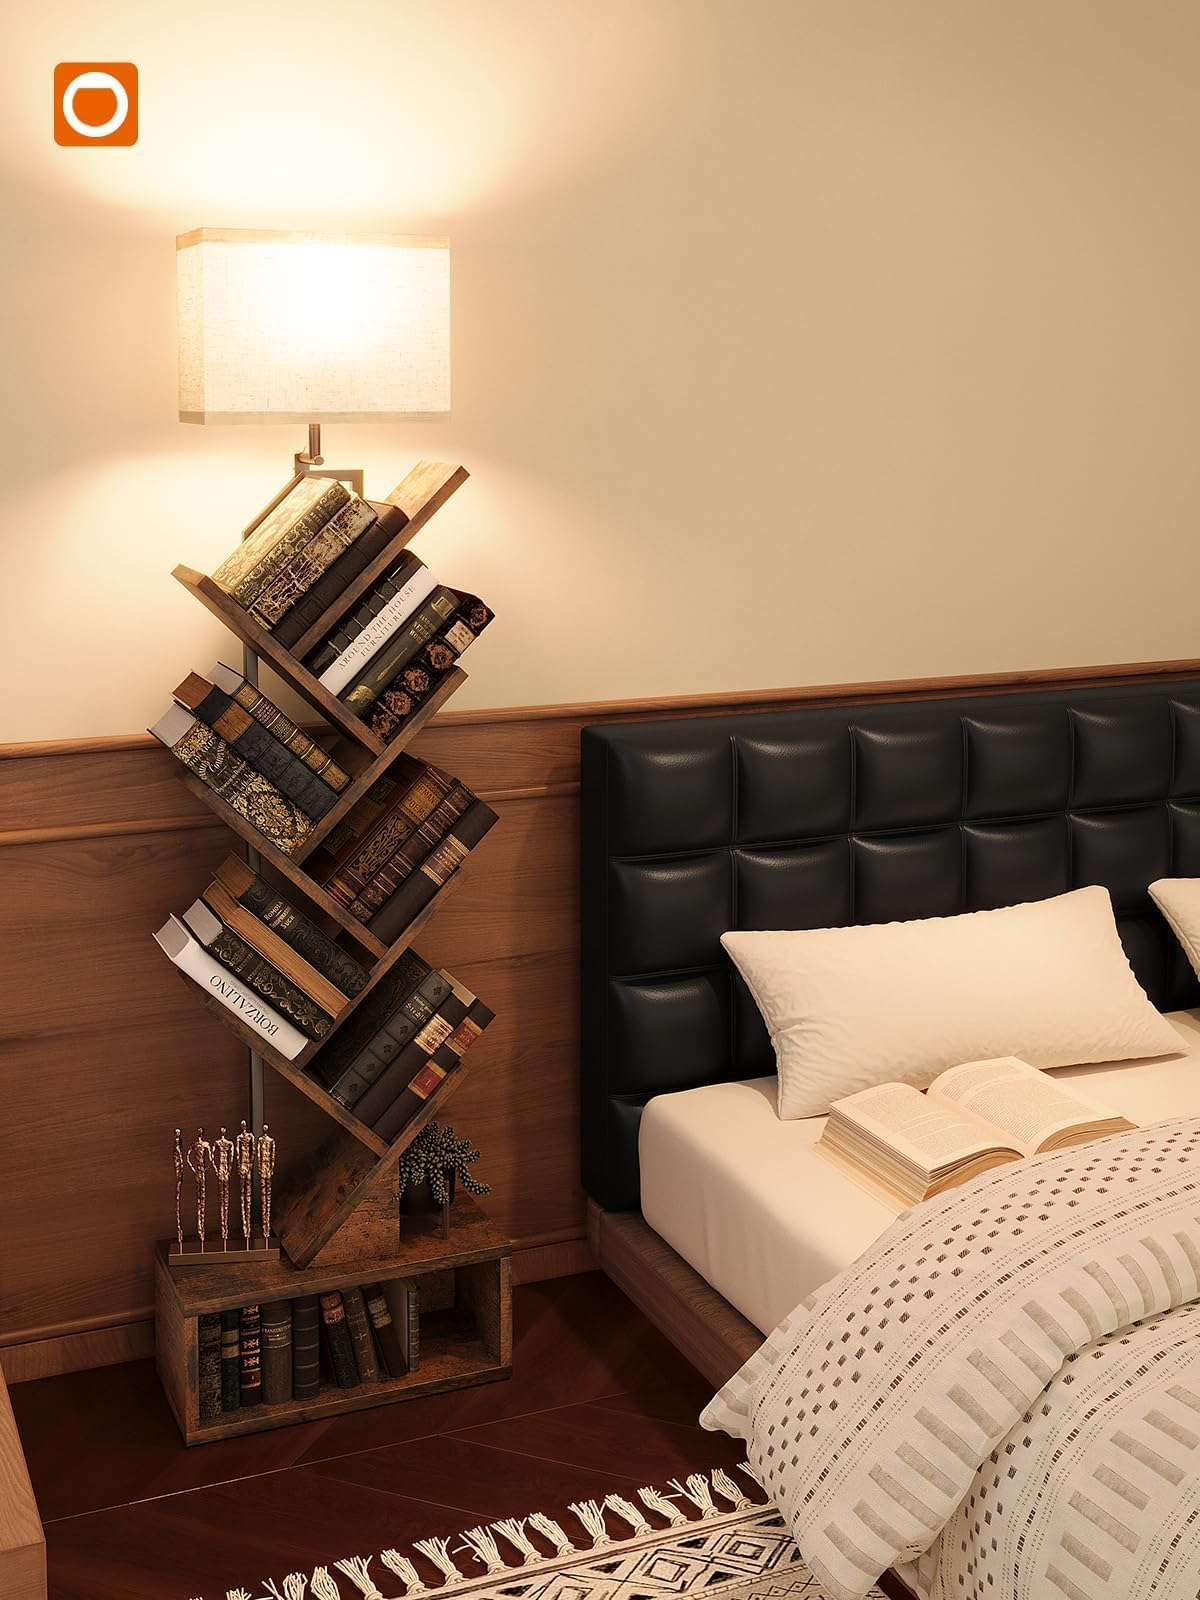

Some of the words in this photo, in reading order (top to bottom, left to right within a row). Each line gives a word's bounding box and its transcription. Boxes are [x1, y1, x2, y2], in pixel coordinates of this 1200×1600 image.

[337, 632, 372, 669] AROUND
[369, 613, 389, 633] THE
[387, 583, 416, 614] HOUSE
[359, 608, 405, 657] FURNITURE
[403, 794, 428, 819] POEMS
[207, 973, 280, 1037] BORZALINO
